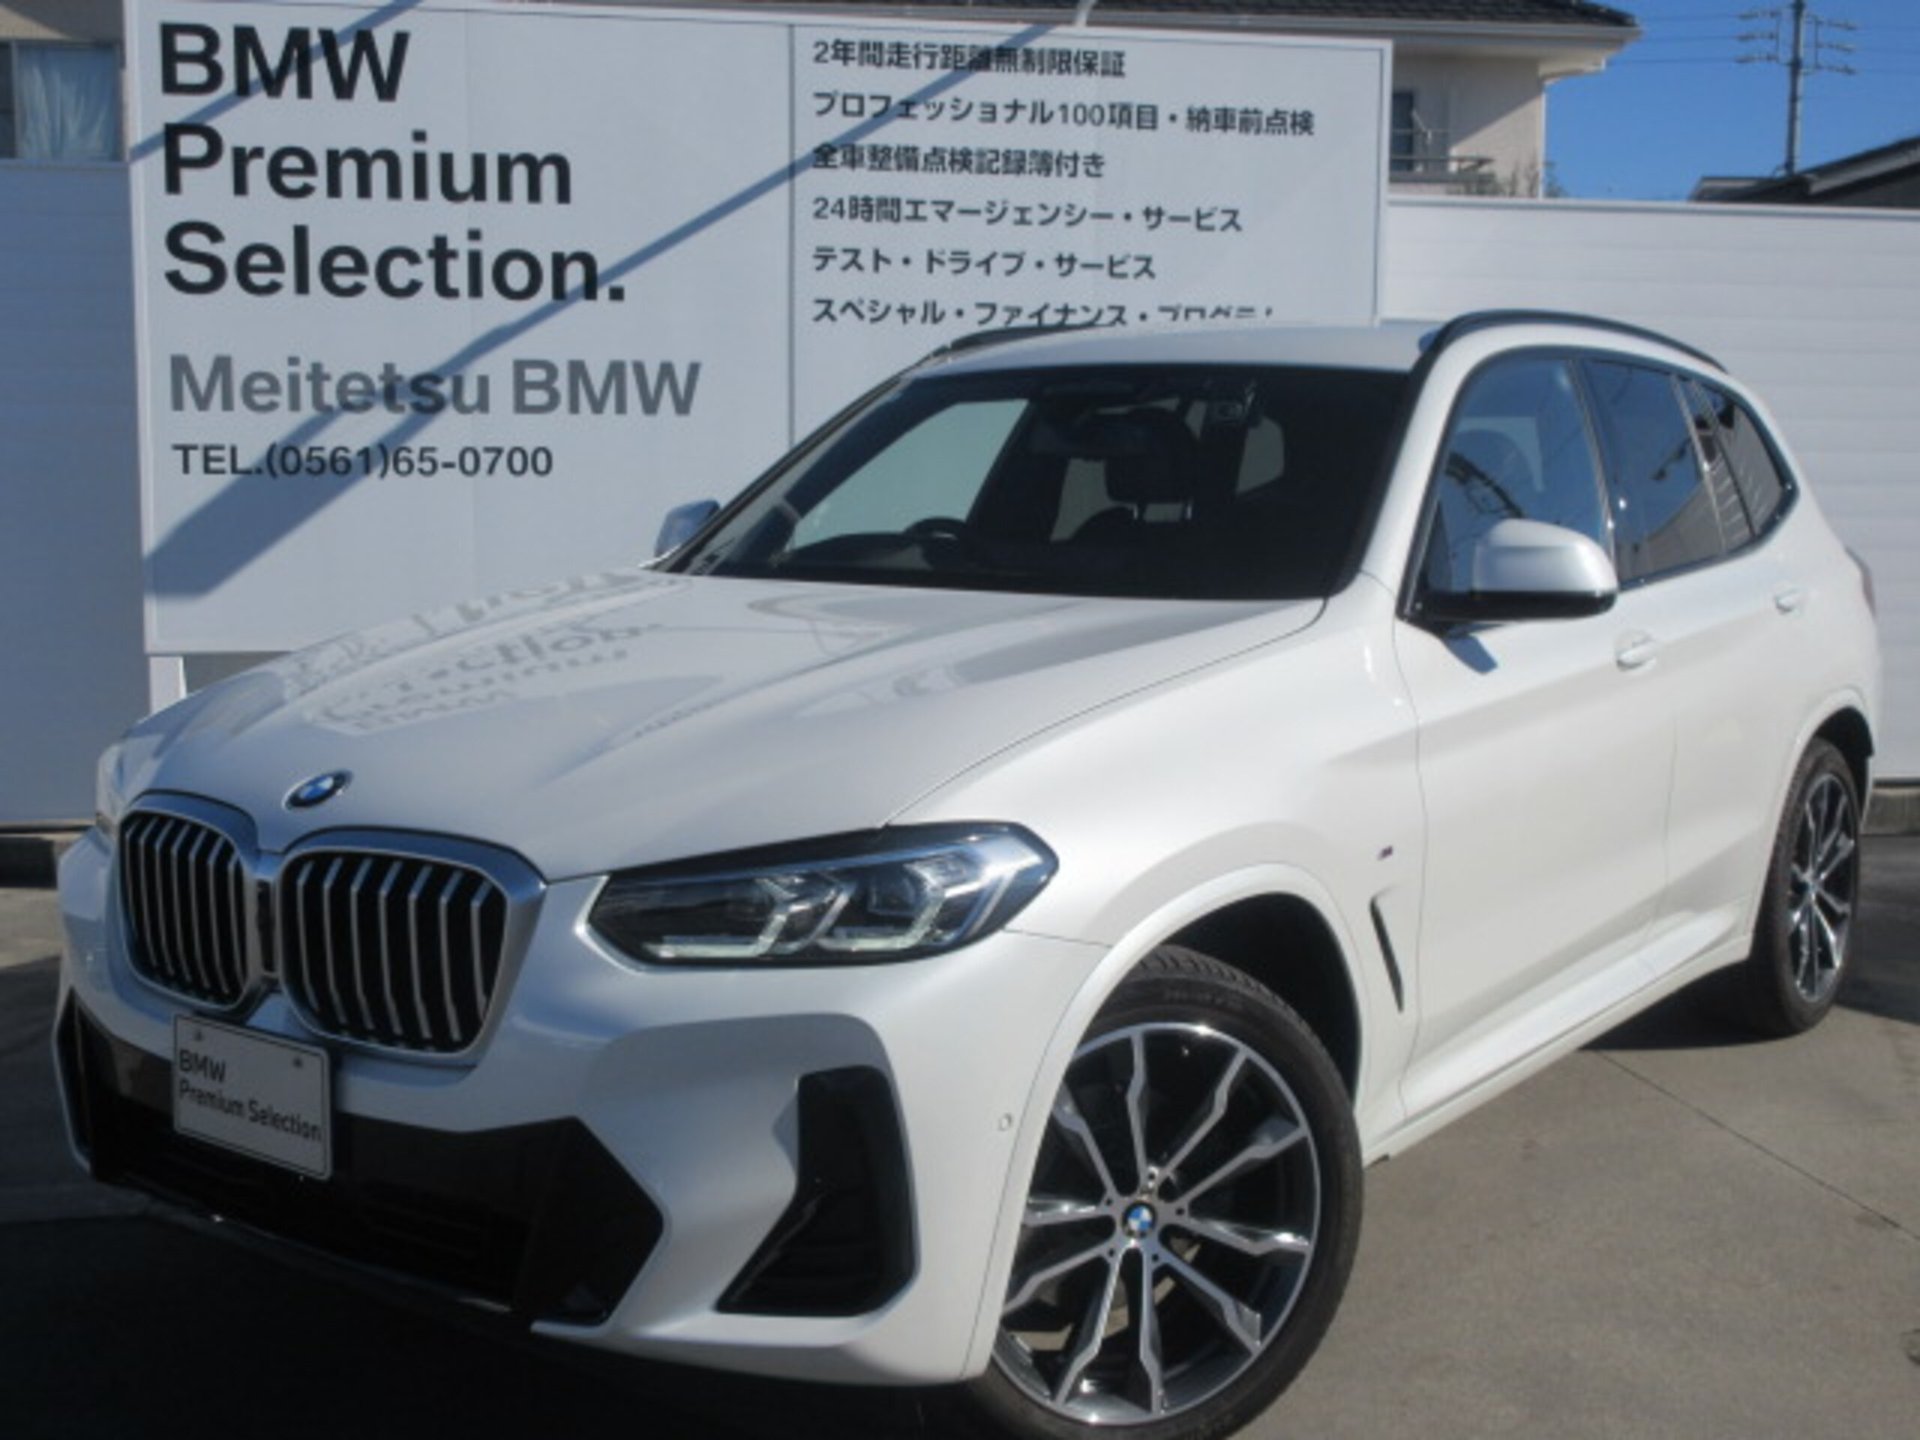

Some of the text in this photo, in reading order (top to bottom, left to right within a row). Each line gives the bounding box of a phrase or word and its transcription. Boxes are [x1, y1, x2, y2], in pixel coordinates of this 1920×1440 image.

[161, 22, 410, 102] BMW
[814, 39, 1124, 78] 2年間走行距離無制限保証
[162, 121, 572, 205] Premium
[813, 195, 1243, 233] 24時間エマージェンシー・サービス
[164, 220, 626, 302] Selection.
[812, 246, 1157, 280] テスト・ドライブ・サービス
[170, 353, 702, 417] Meitetsu BMW
[172, 442, 554, 480] TEL.(0561)65-0700
[178, 1048, 227, 1083] BMW
[178, 1077, 323, 1143] Premium Selection
